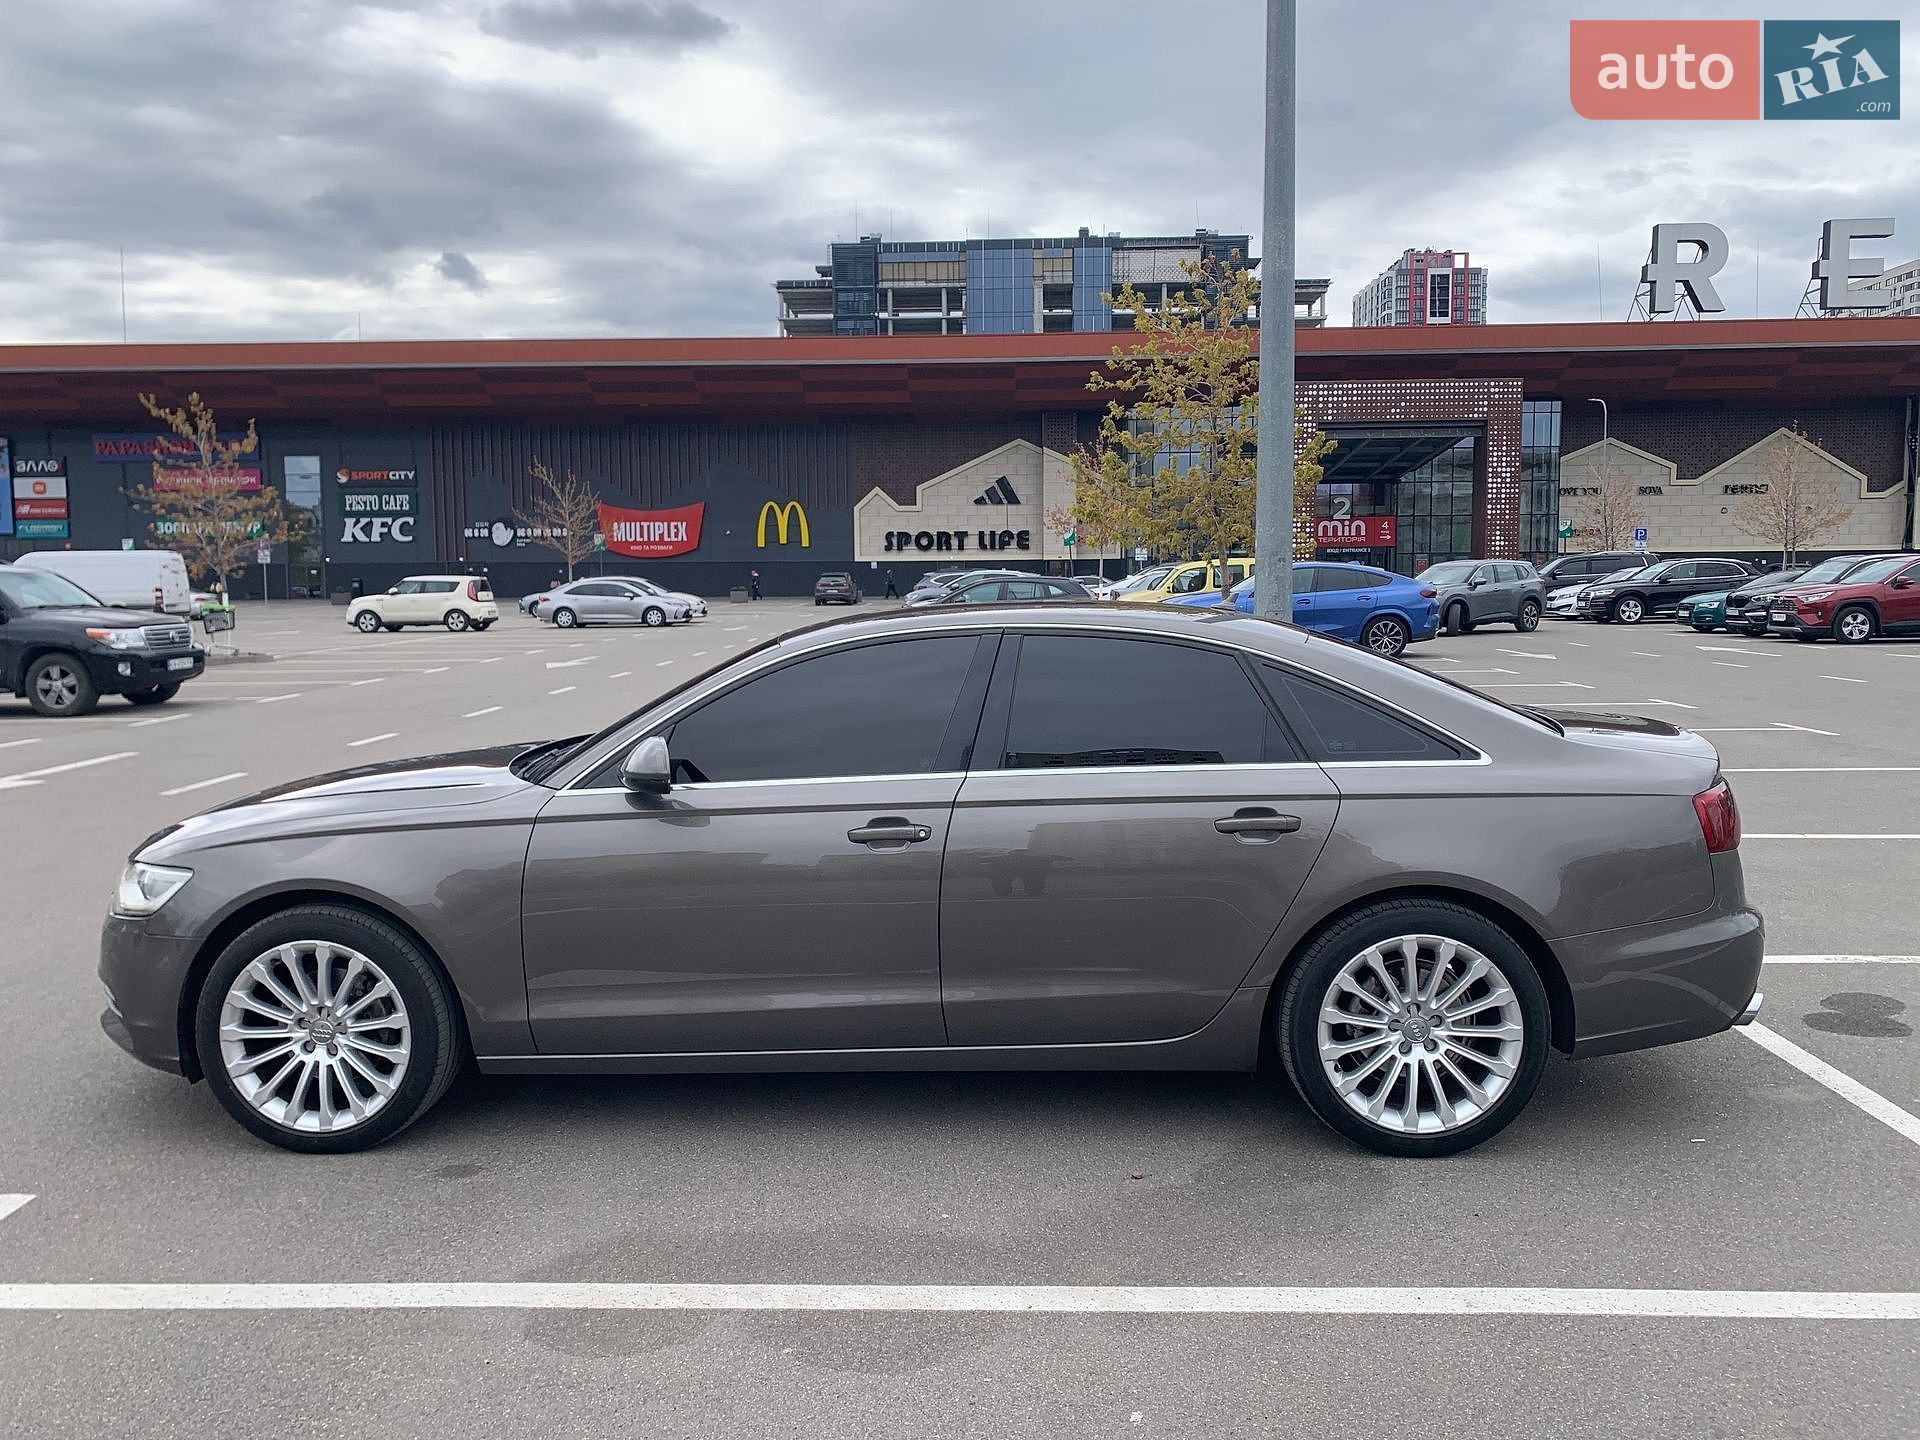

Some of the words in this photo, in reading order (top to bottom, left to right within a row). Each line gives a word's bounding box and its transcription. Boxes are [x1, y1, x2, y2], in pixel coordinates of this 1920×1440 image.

[1639, 486, 1663, 495] SOVA
[344, 494, 379, 511] PESTO
[382, 494, 410, 511] CAFE
[1333, 496, 1351, 520] 2
[340, 516, 415, 542] KFC
[613, 521, 688, 542] MULTIPLEX
[1317, 520, 1366, 537] min
[884, 530, 968, 551] SPORT
[978, 529, 1030, 550] LIFE
